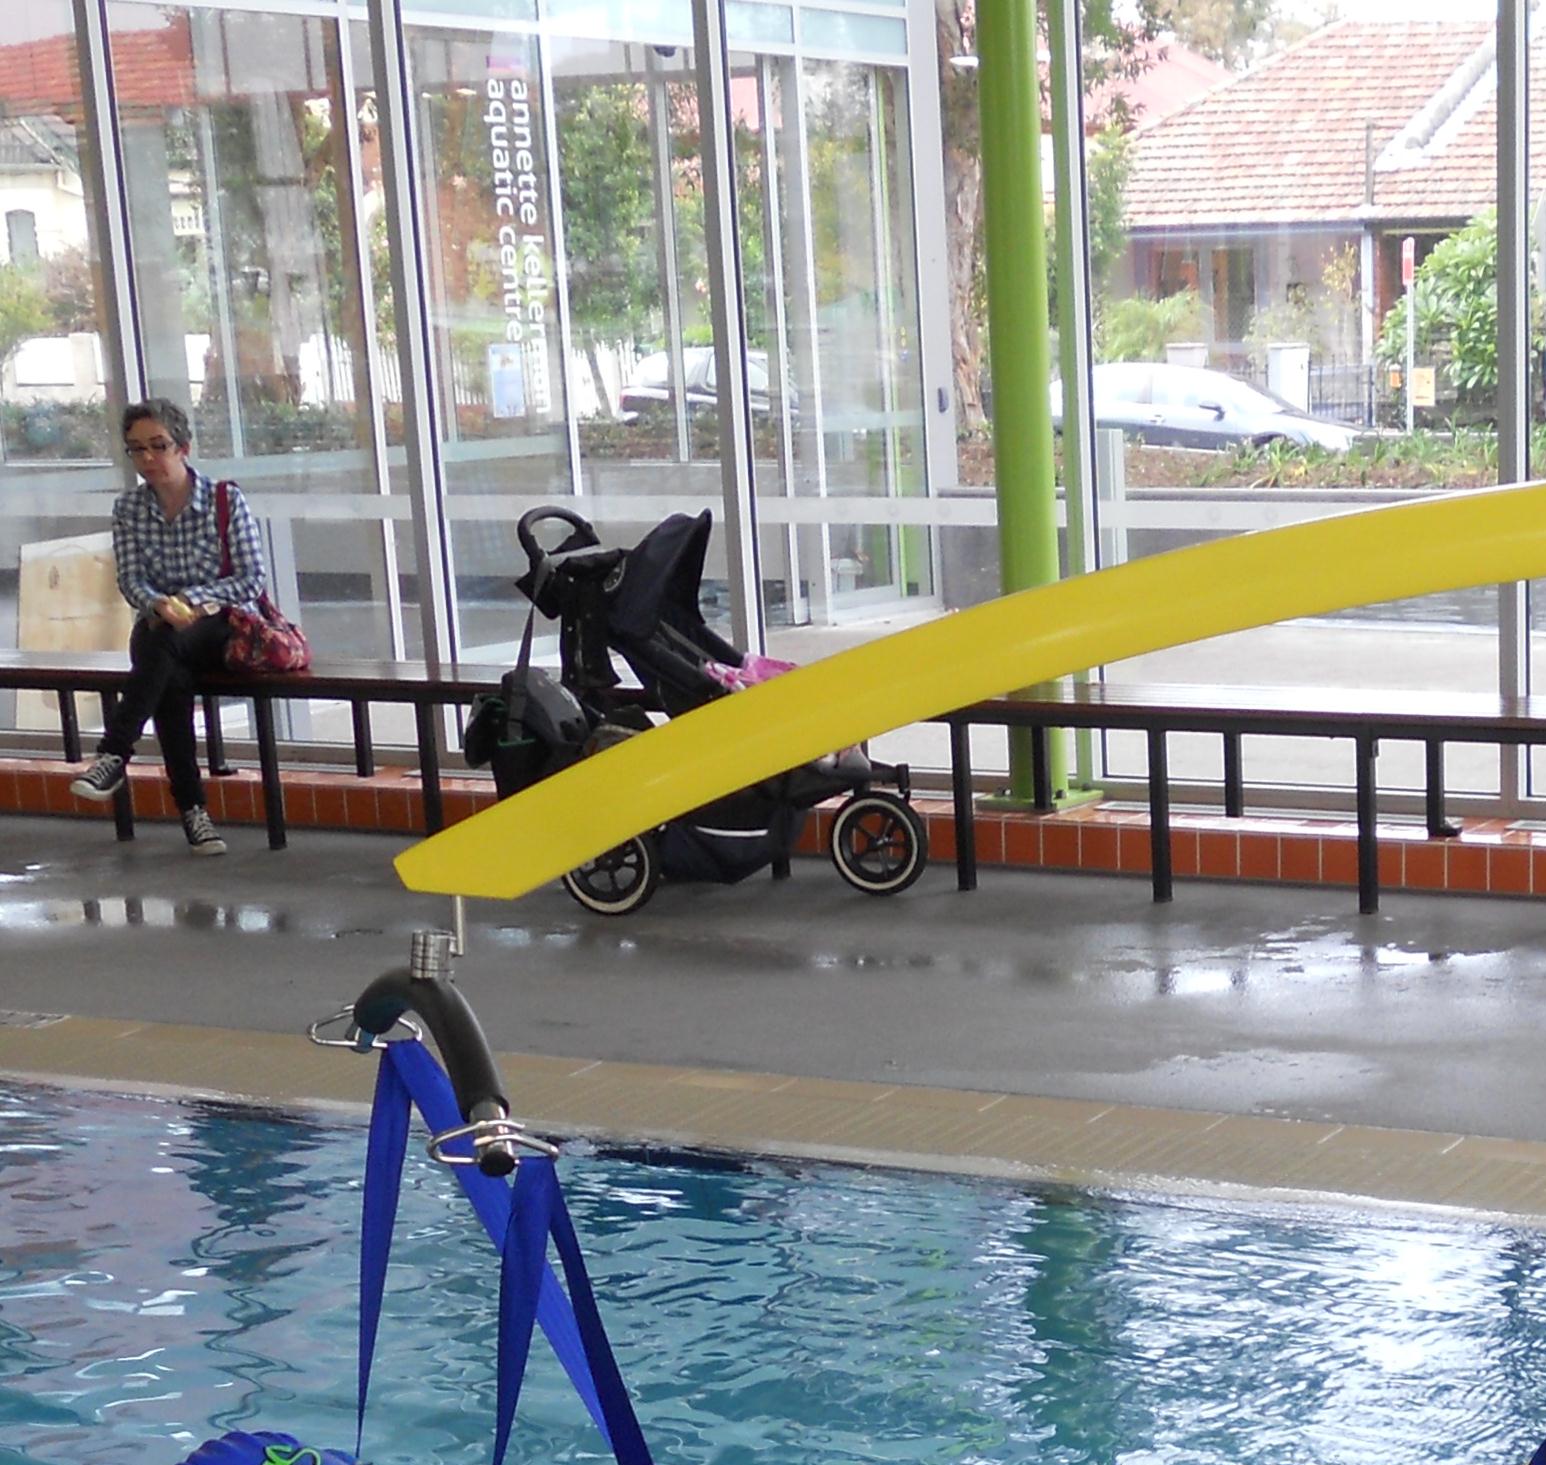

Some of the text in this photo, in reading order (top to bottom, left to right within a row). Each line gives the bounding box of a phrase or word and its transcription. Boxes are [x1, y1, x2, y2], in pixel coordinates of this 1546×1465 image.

[483, 78, 523, 342] aquatic centre
[510, 79, 537, 225] annette
